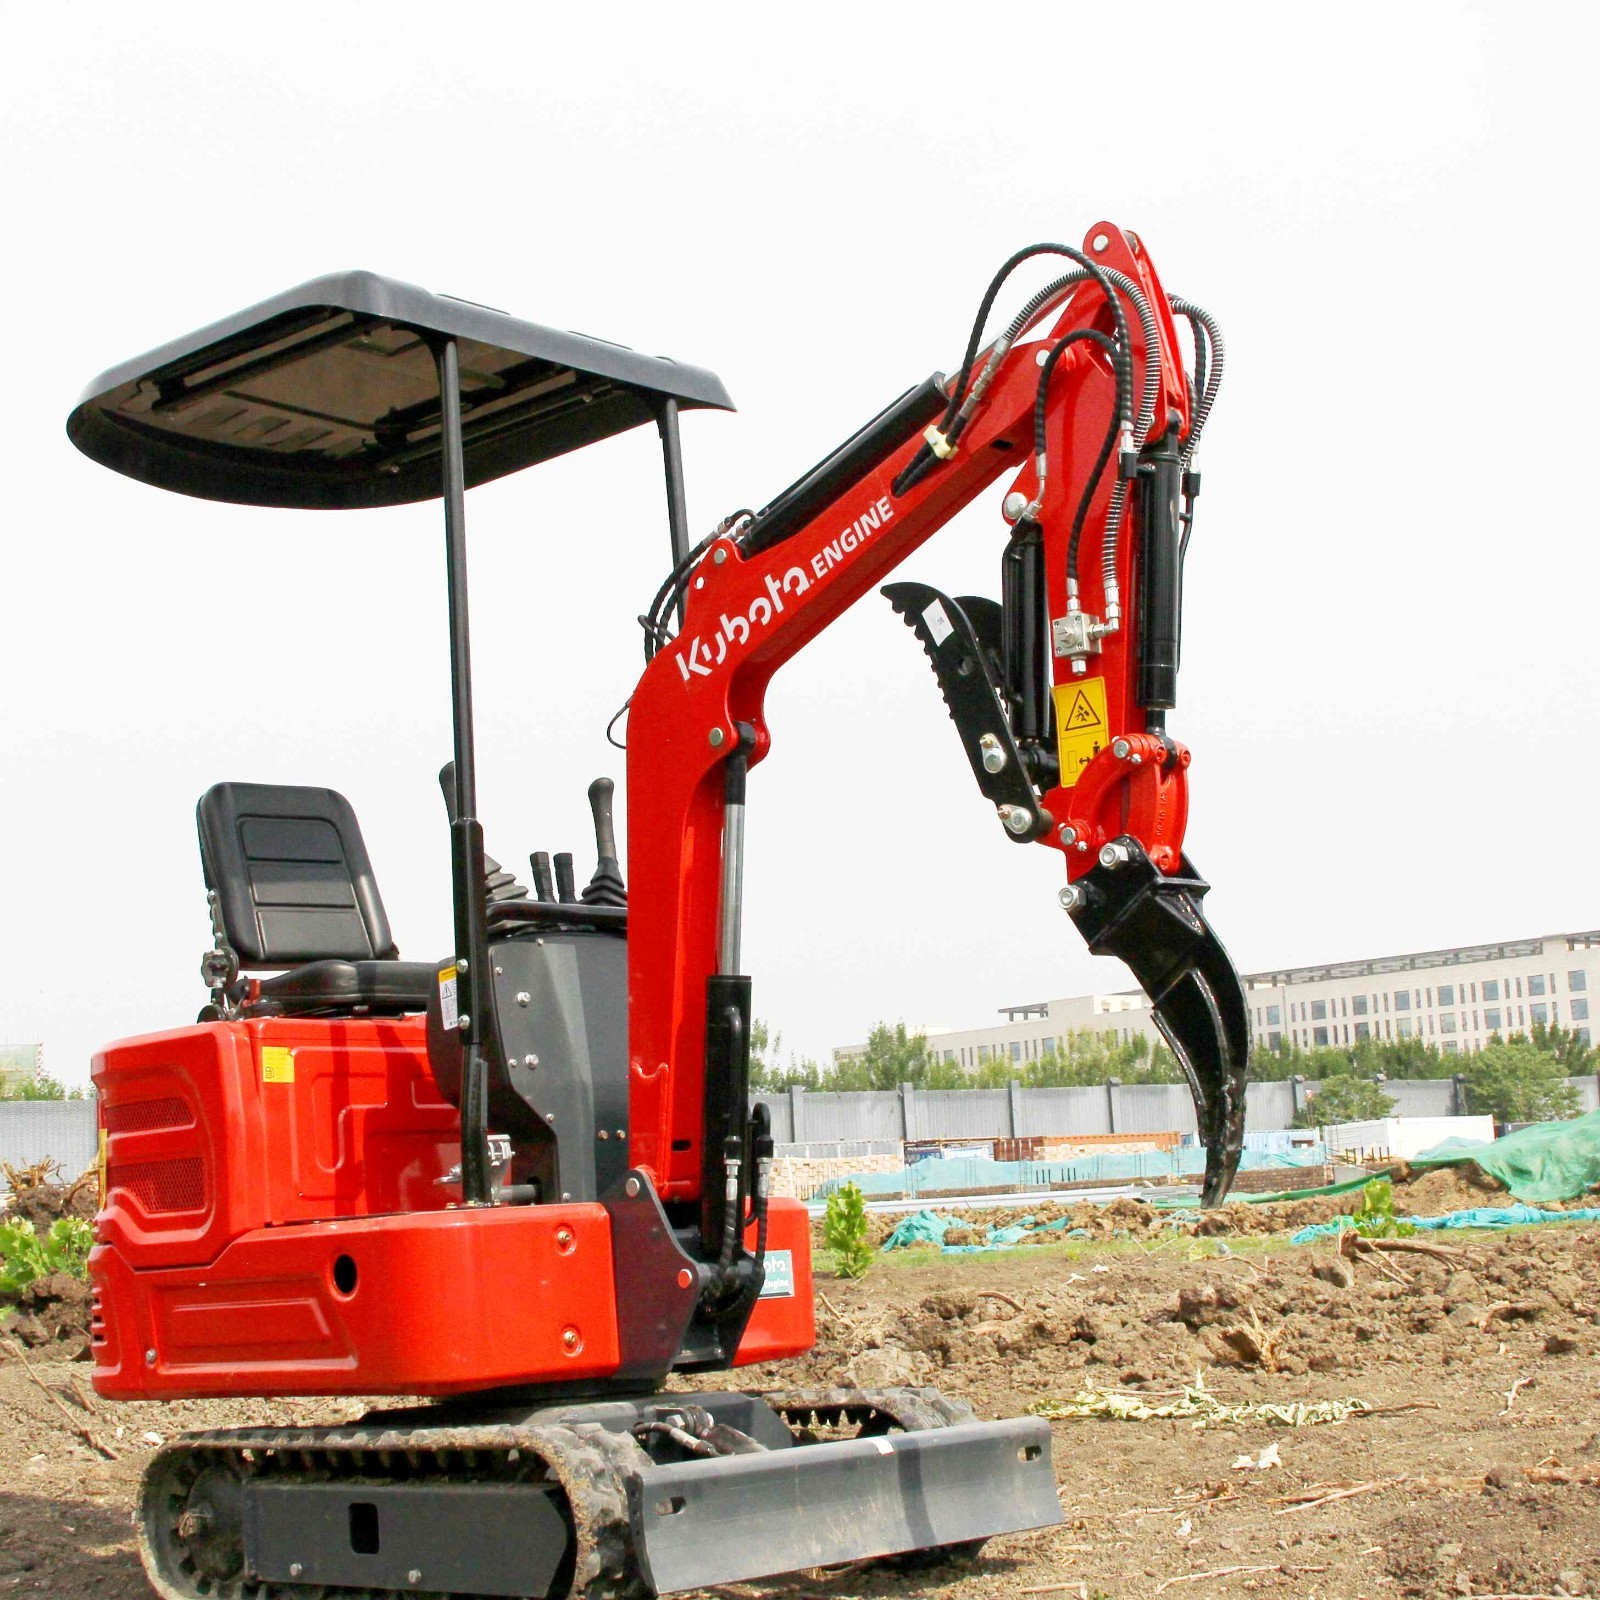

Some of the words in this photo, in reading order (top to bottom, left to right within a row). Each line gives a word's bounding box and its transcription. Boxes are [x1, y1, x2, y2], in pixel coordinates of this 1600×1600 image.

[675, 566, 810, 681] Kubota
[810, 496, 894, 579] ENGINE
[763, 1256, 786, 1273] ota
